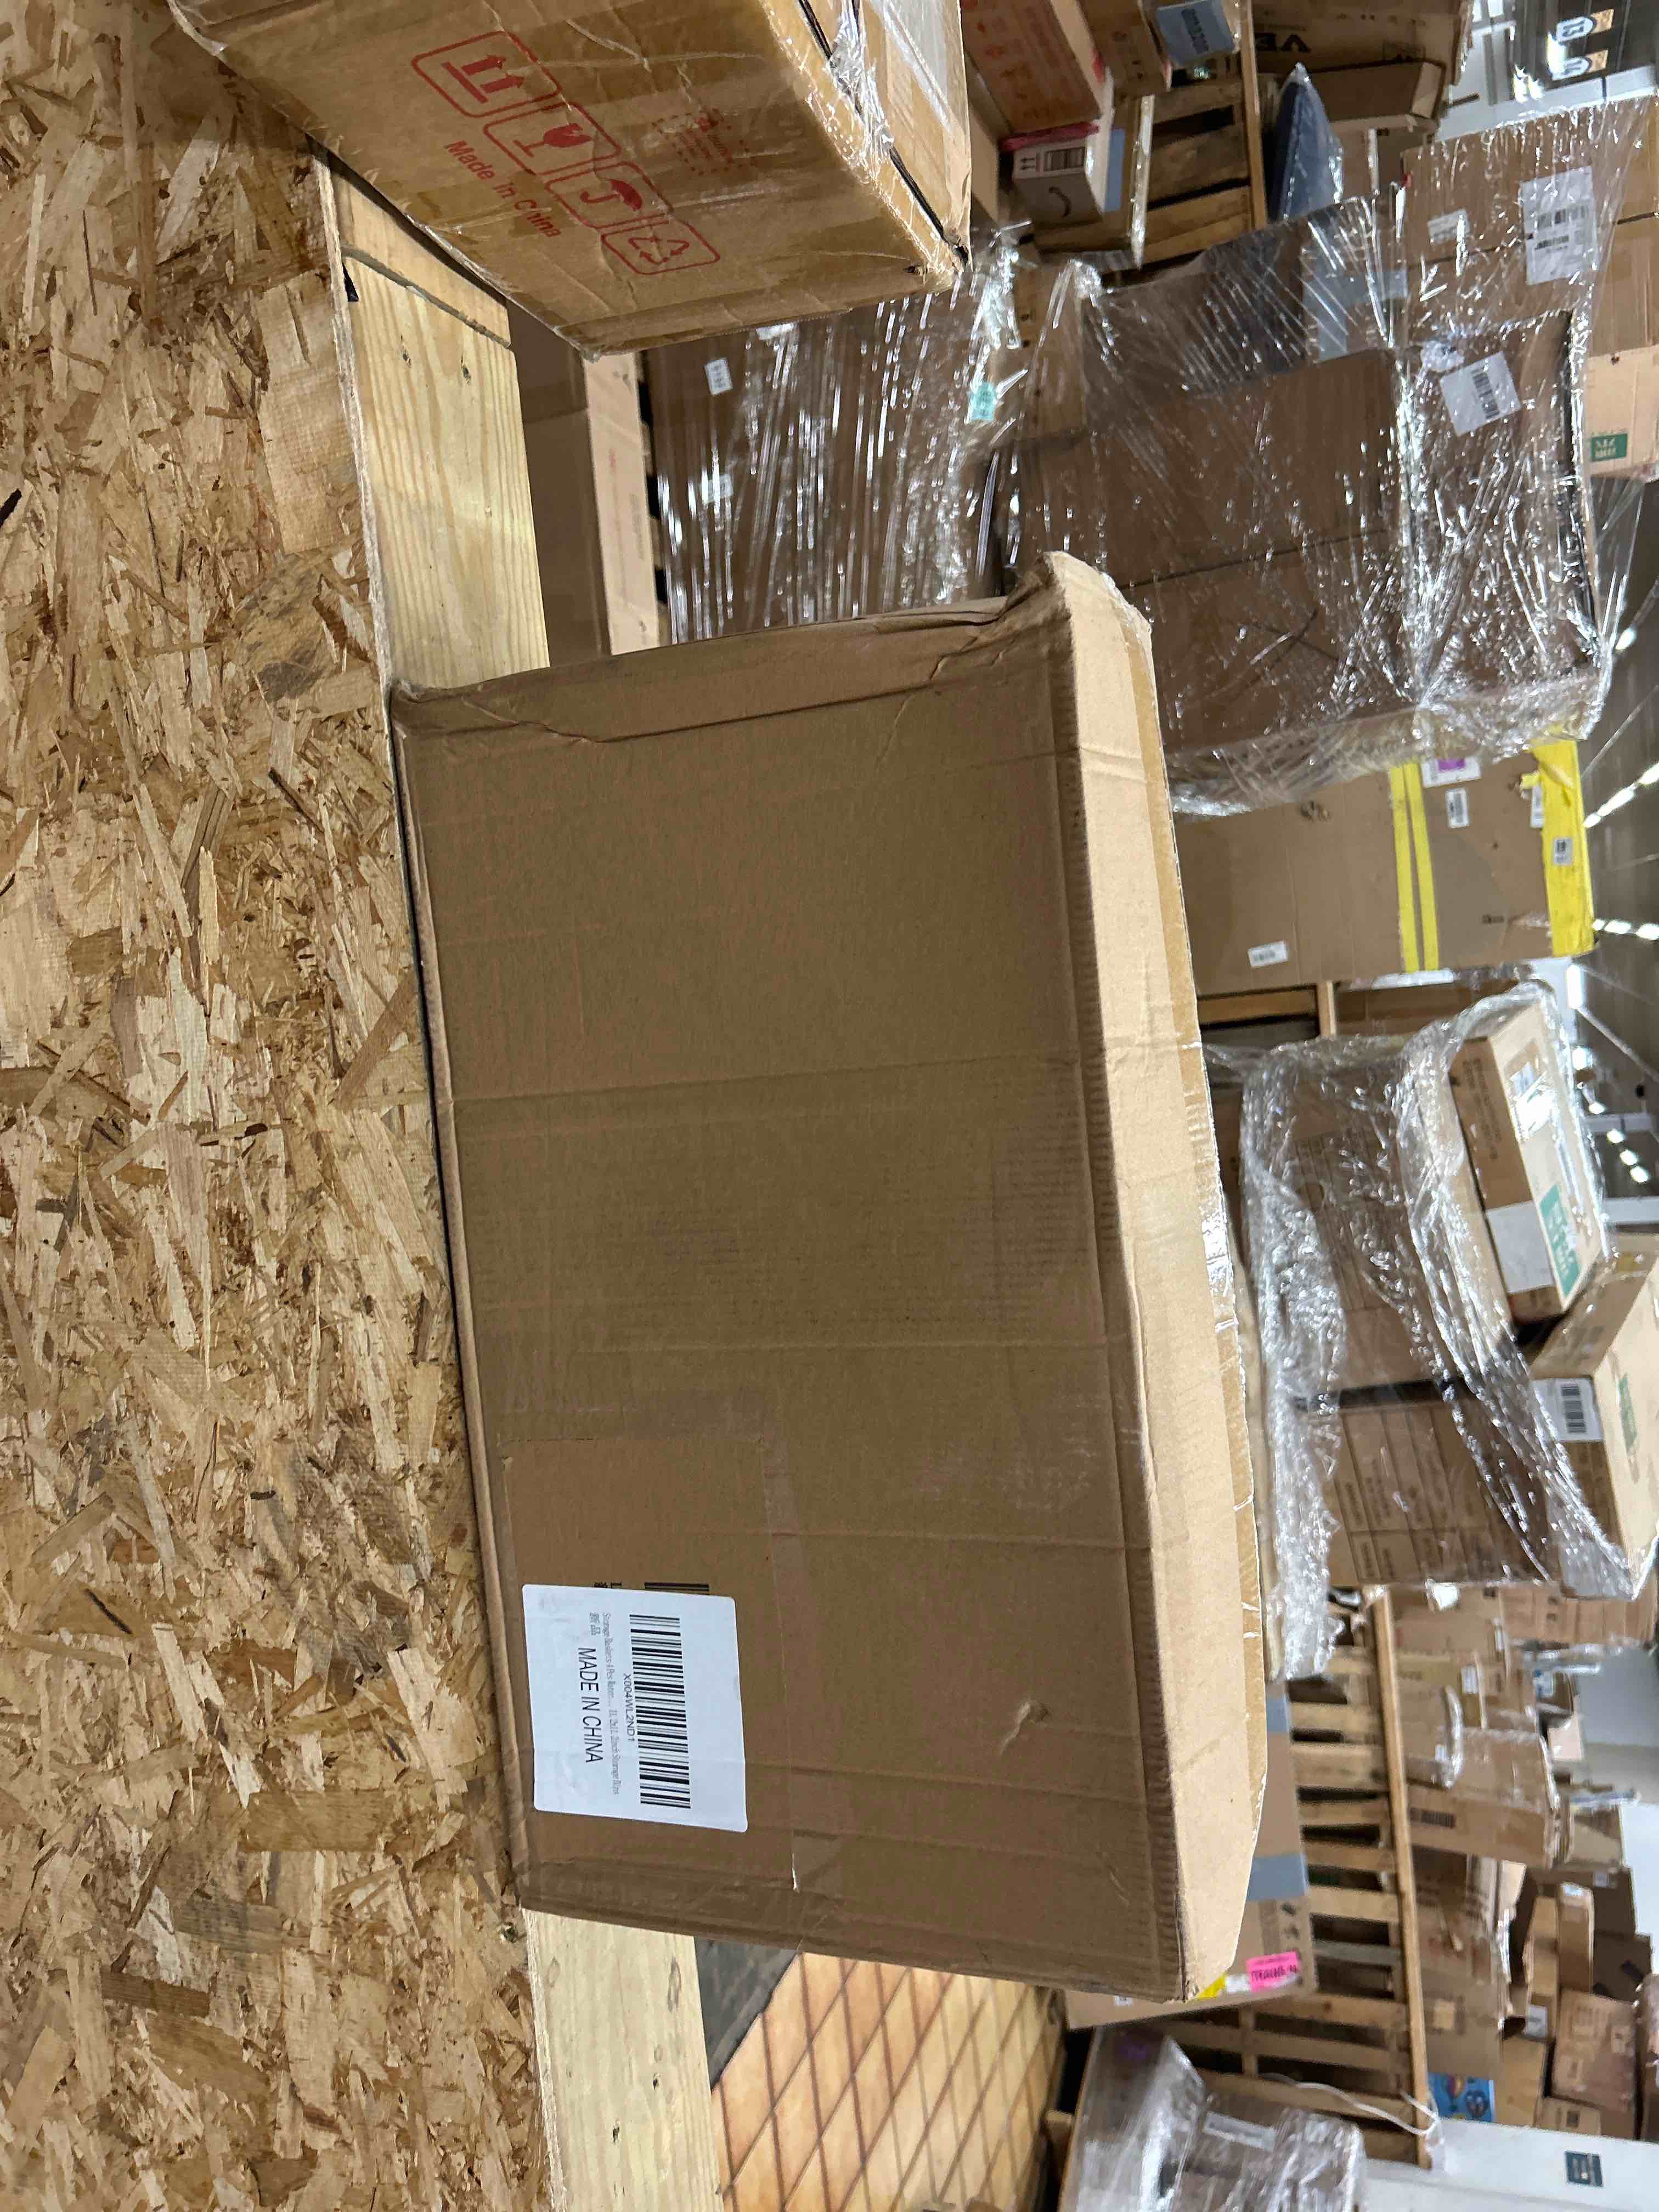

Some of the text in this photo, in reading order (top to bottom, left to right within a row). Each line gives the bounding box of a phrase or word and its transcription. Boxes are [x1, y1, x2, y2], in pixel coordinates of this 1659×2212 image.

[444, 140, 495, 180] Made
[492, 183, 516, 199] in
[578, 1647, 603, 1763] MADE IN CHINA
[623, 1673, 635, 1742] X004WL2ND1
